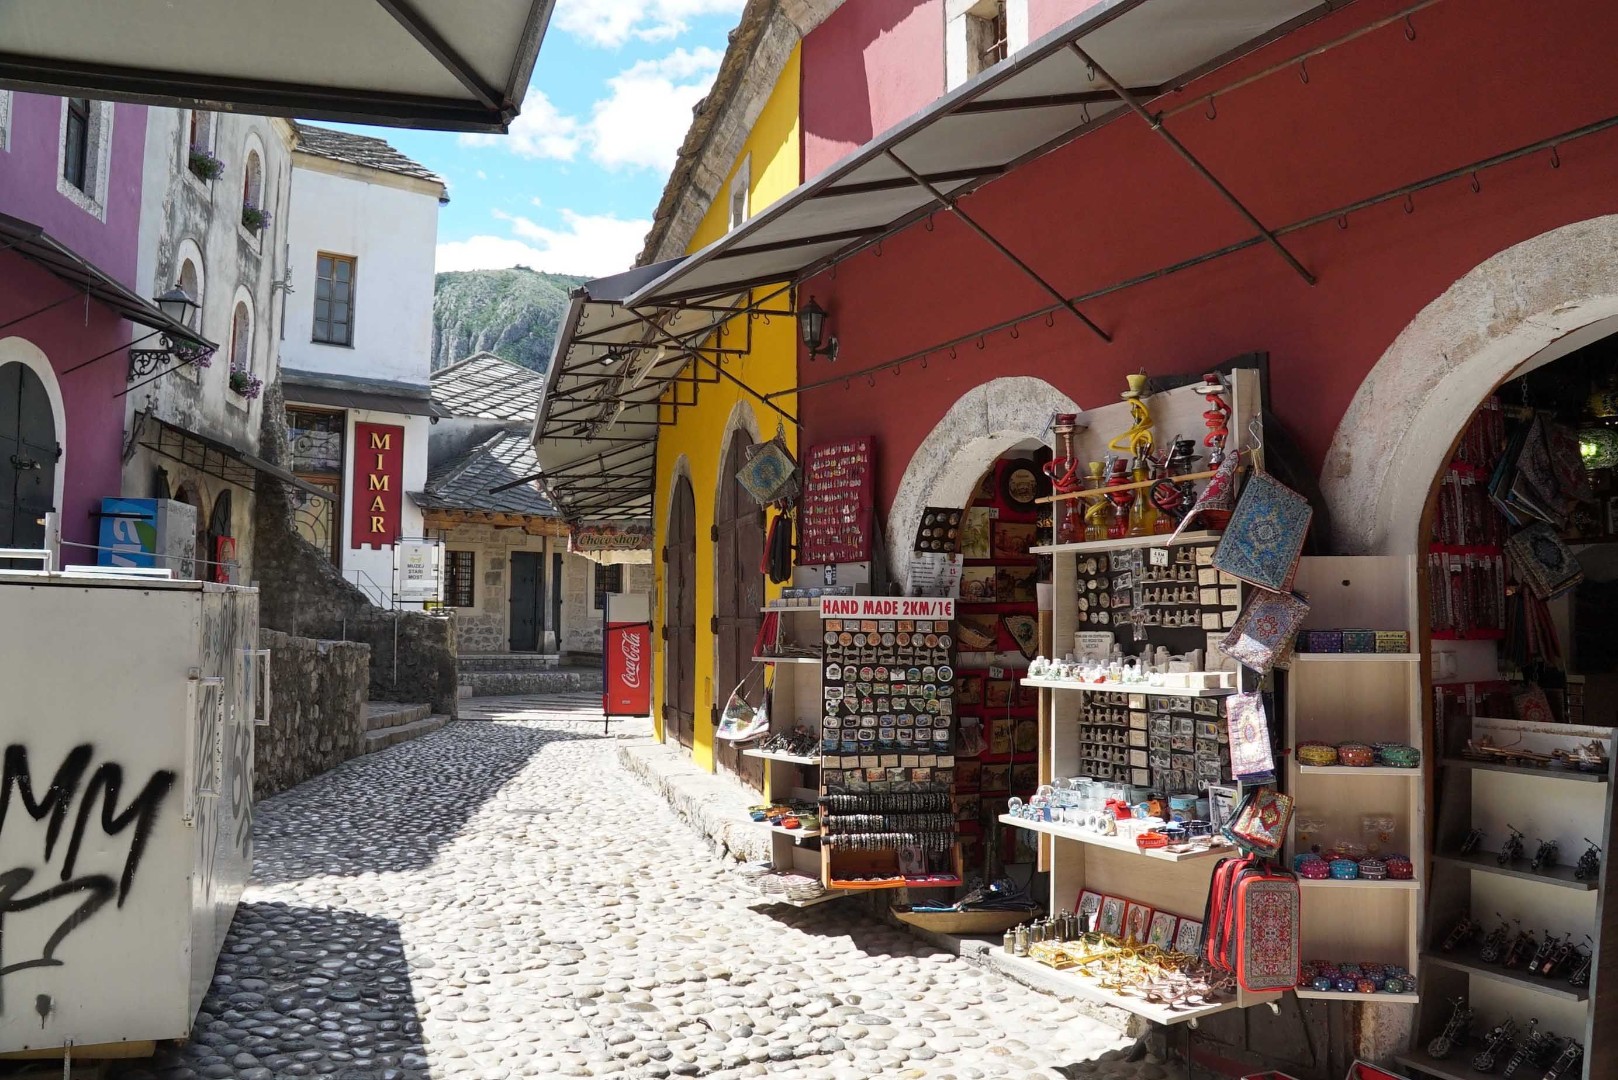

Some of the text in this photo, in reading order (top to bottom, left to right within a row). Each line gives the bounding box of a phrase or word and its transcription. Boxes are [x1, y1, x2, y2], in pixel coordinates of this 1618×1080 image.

[369, 432, 391, 533] MIMAR
[580, 533, 640, 546] Choco shop
[823, 599, 952, 616] HAND MADE 2KM/1€
